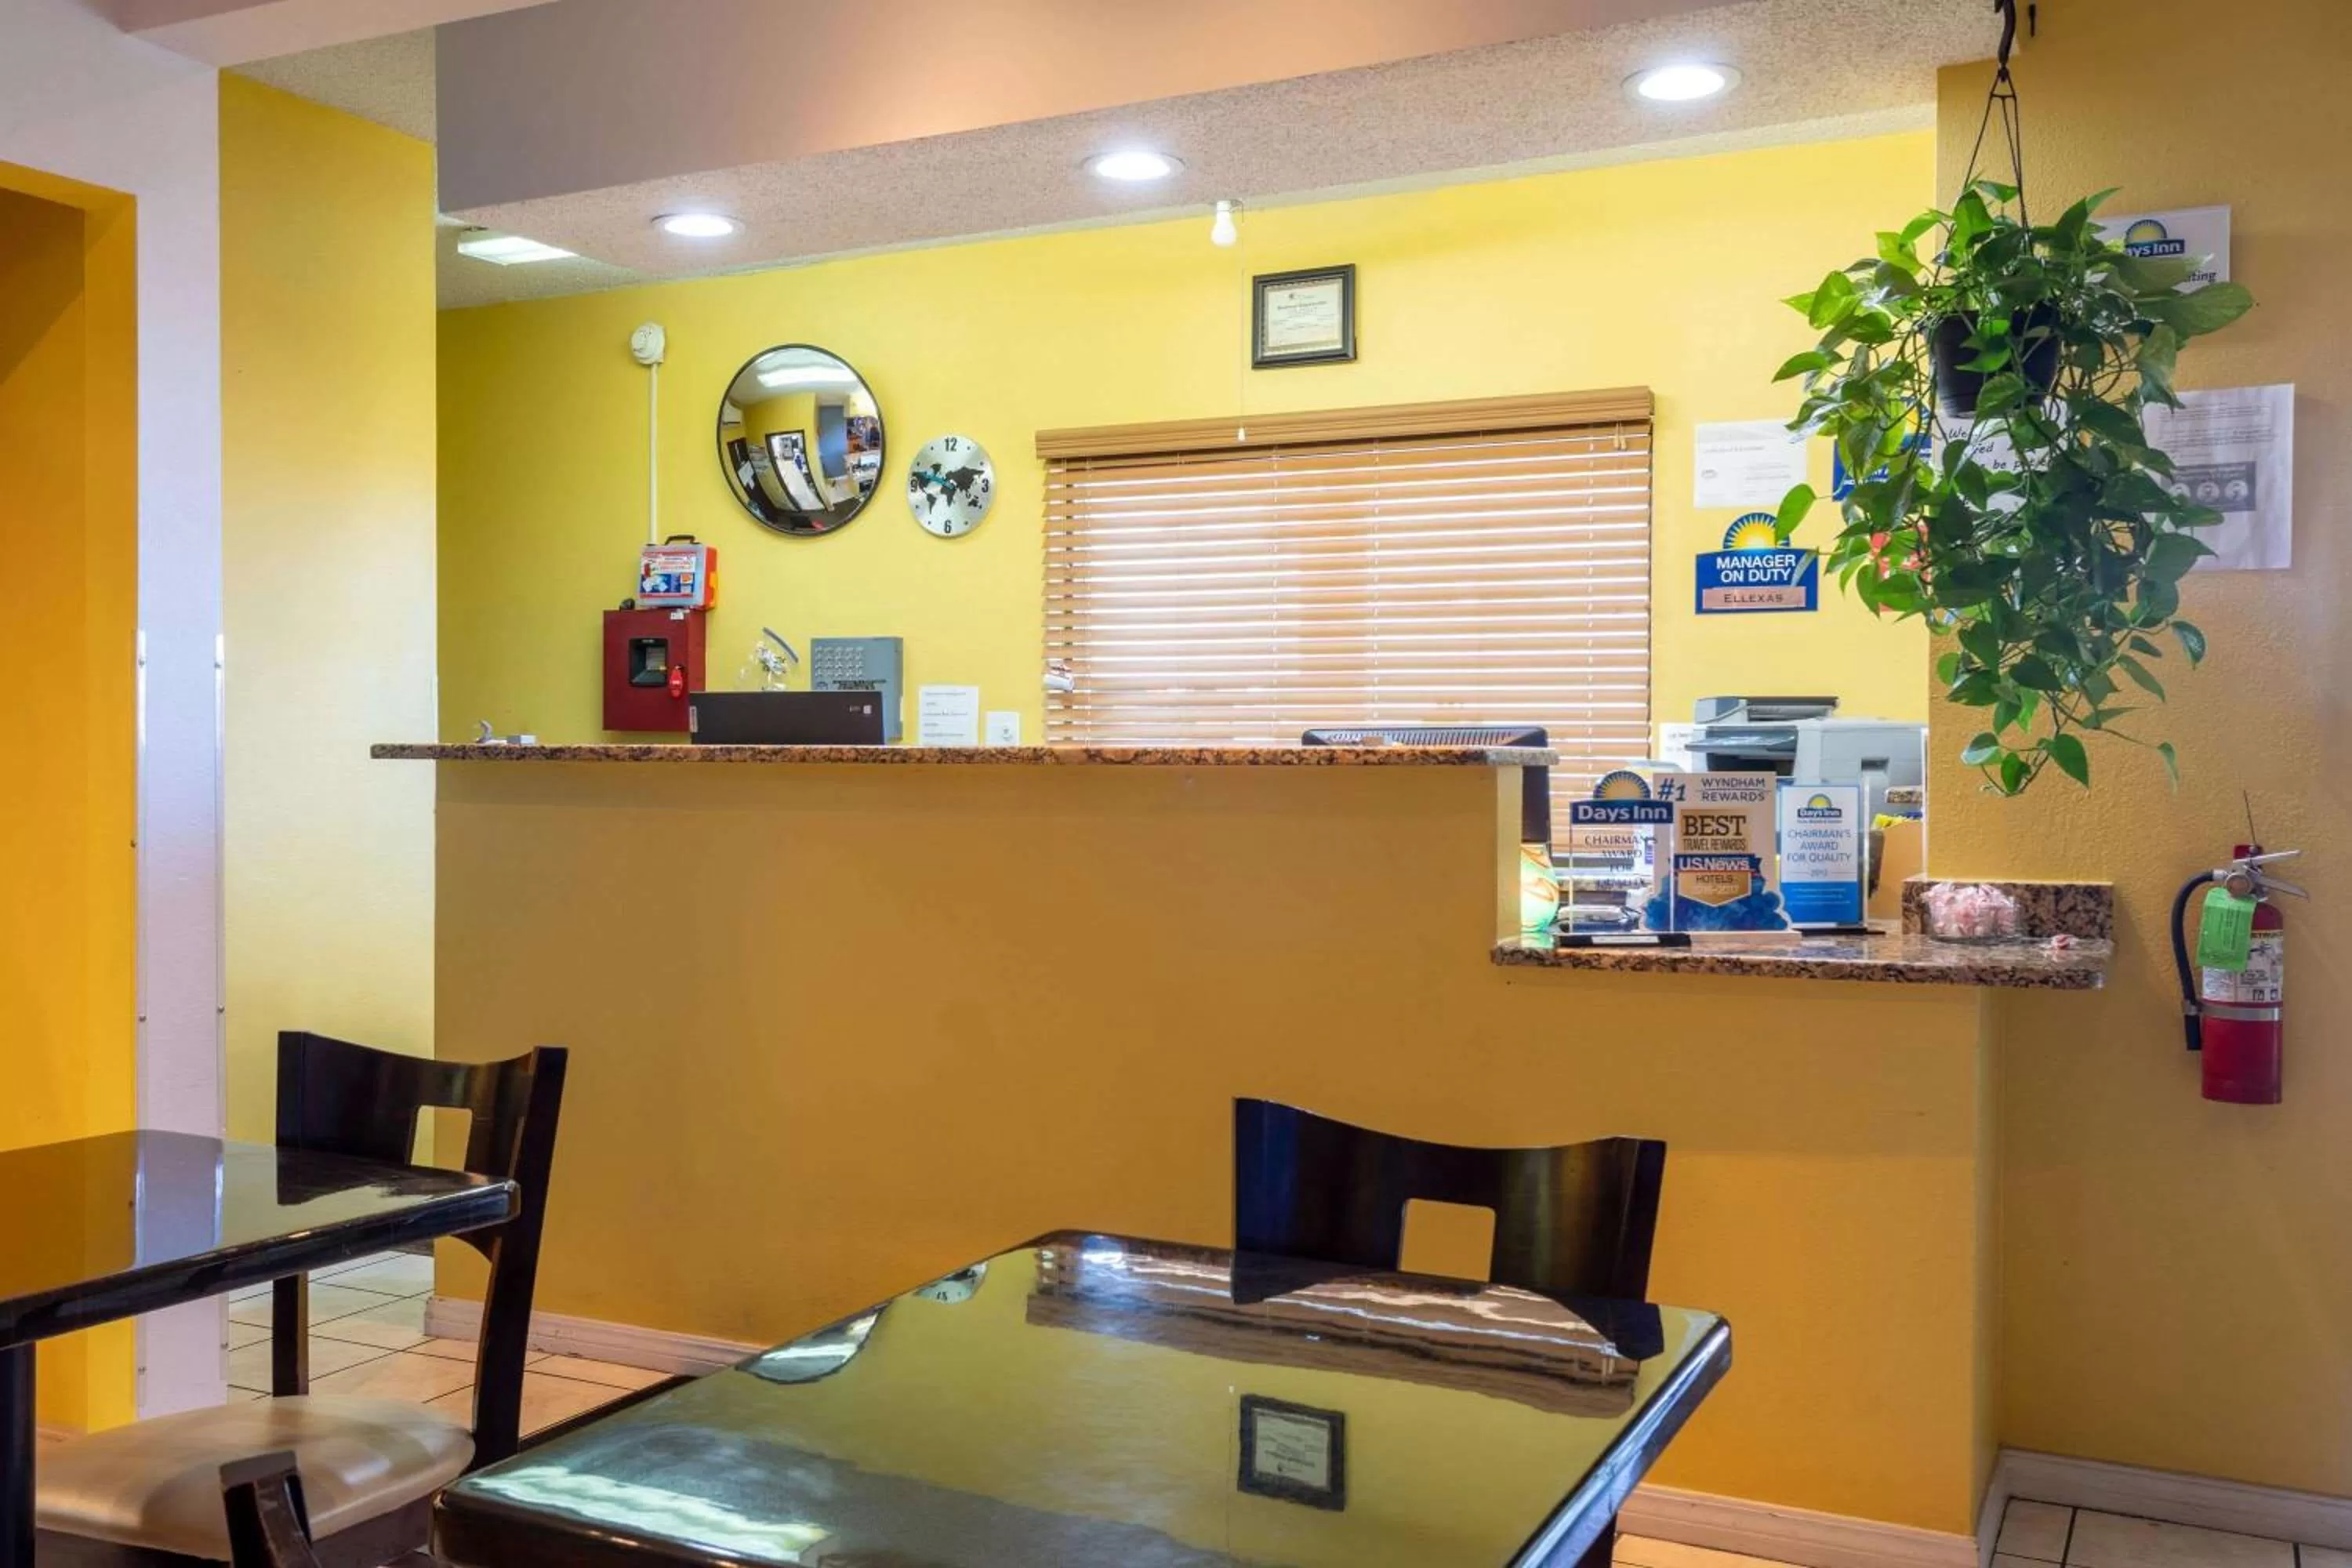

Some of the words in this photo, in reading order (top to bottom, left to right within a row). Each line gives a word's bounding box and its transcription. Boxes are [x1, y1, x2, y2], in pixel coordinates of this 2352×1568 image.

[2154, 241, 2181, 255] Inn
[945, 437, 957, 452] 12
[910, 477, 918, 492] 9
[981, 477, 989, 493] 3
[944, 520, 952, 533] 6
[1715, 554, 1796, 570] MANAGER
[1721, 570, 1743, 583] ON
[1748, 568, 1791, 583] DUTY
[1723, 593, 1784, 604] ELLEXAS
[1700, 777, 1766, 788] WYNDHAM
[1657, 778, 1686, 802] #1
[1701, 791, 1766, 802] REWARDS
[1577, 804, 1630, 822] Days
[1633, 804, 1668, 820] Inn
[1682, 815, 1747, 837] BEST
[1787, 829, 1852, 839] CHAIRMAN'S
[1682, 838, 1708, 851] TRAVEL
[1710, 838, 1746, 851] REWARDS
[1799, 841, 1838, 851] AWARD
[1787, 852, 1806, 862] FOR
[1809, 852, 1852, 863] QUALITY
[1696, 873, 1733, 884] HOTELS
